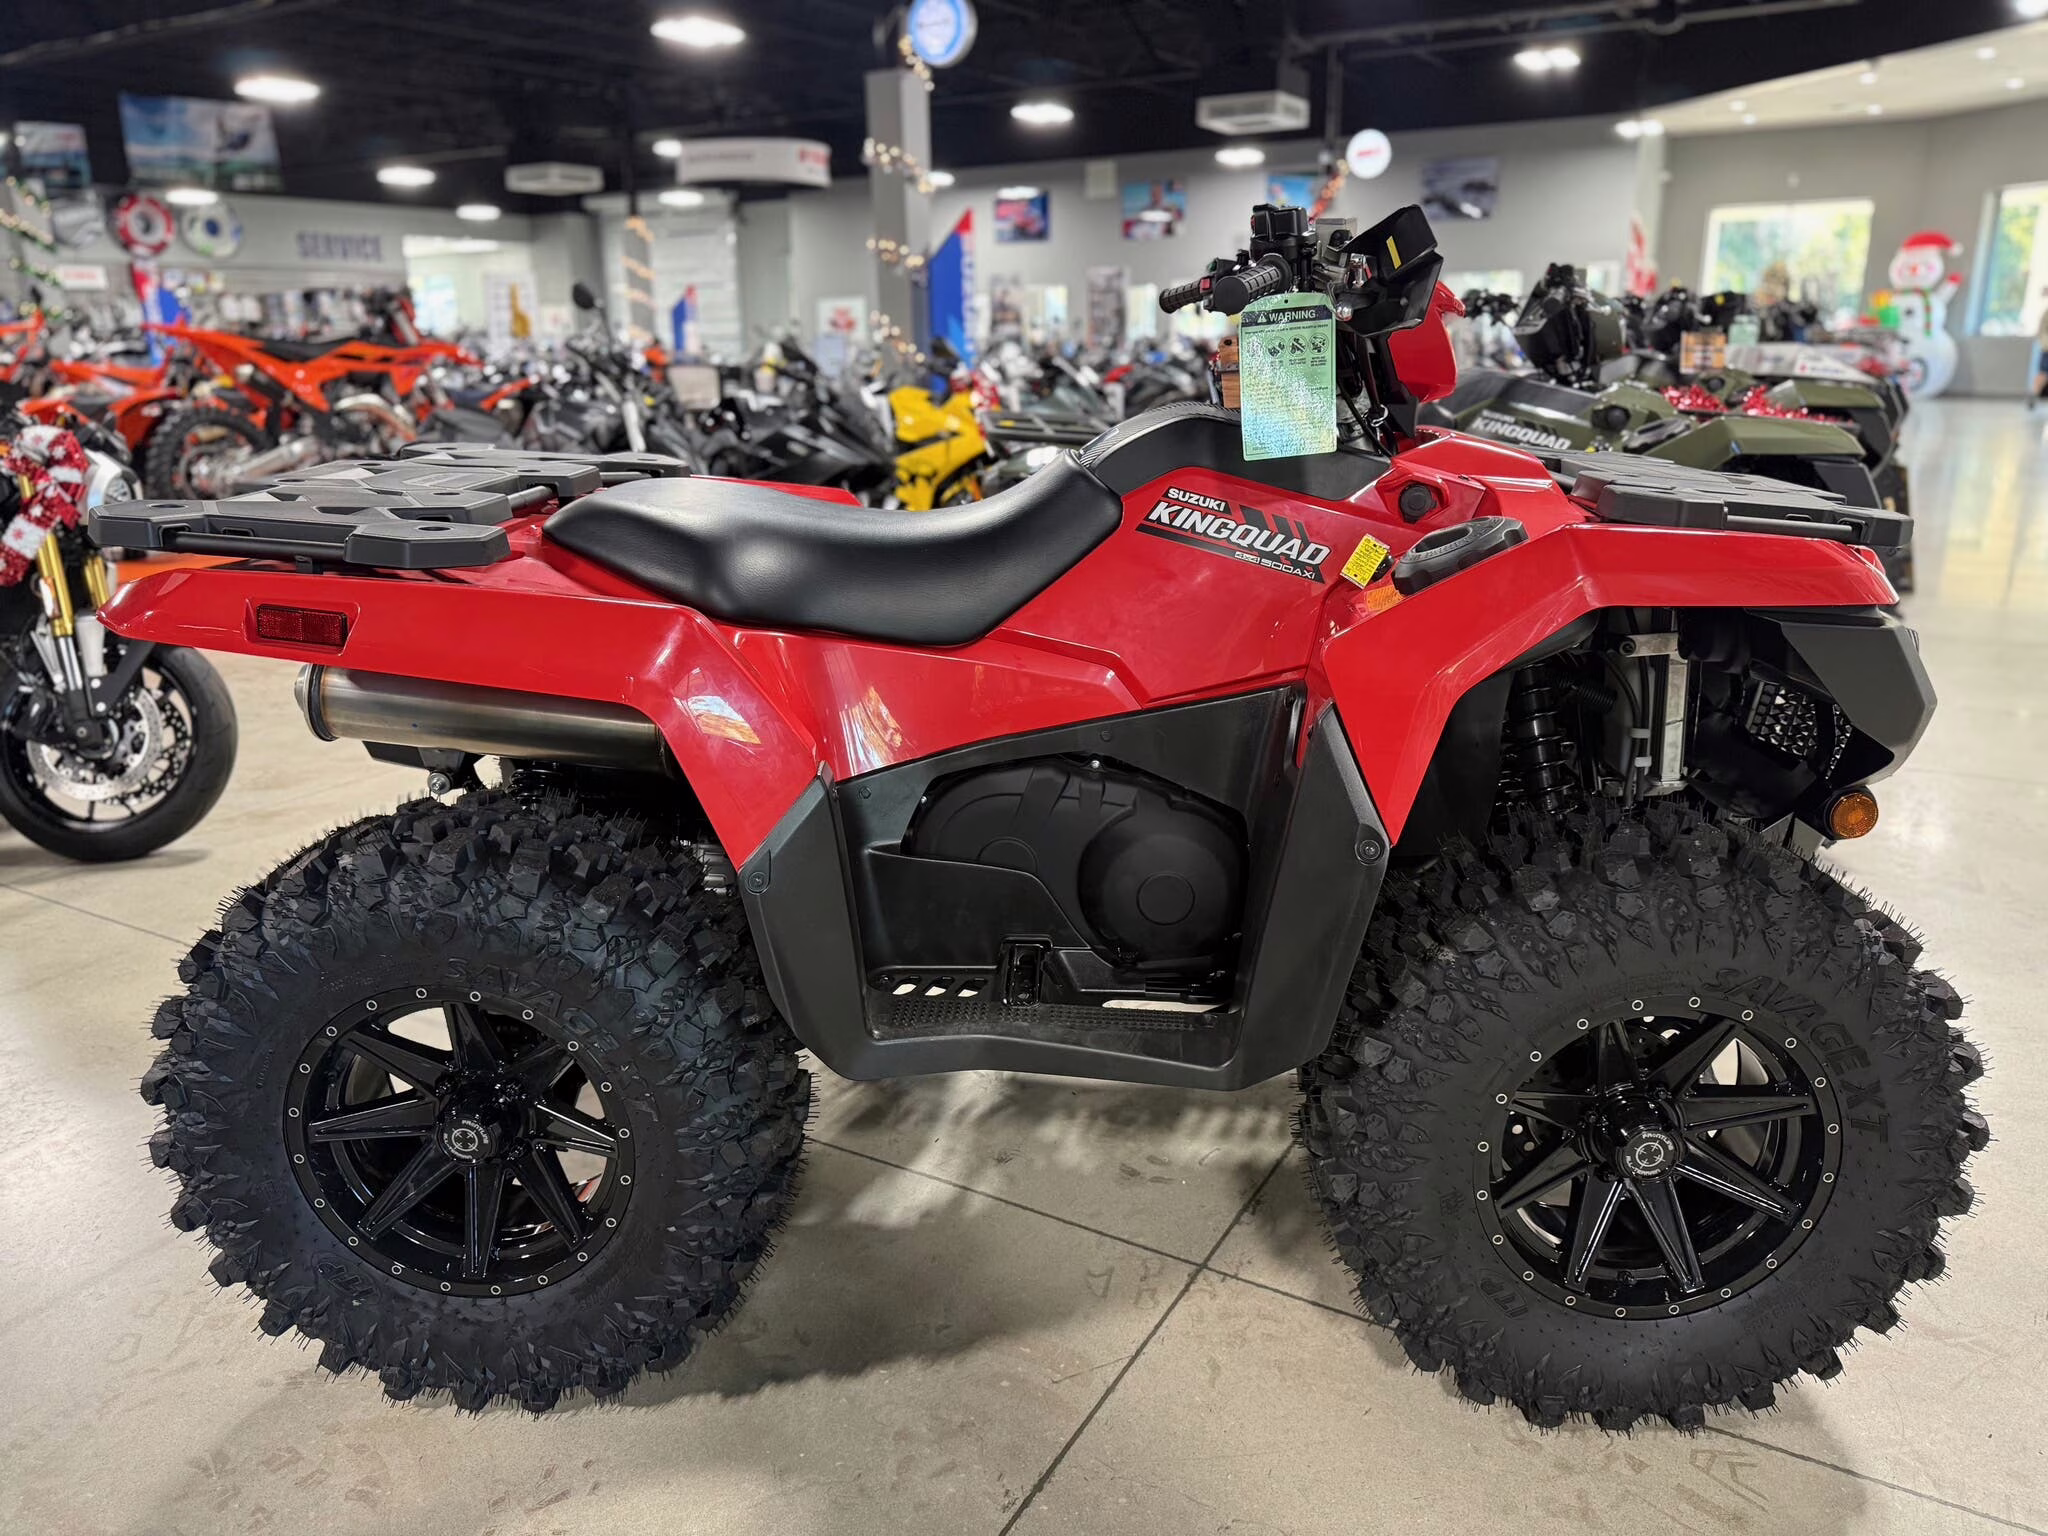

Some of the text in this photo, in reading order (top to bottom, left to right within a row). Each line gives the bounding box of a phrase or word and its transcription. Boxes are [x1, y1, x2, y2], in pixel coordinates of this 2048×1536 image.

[295, 231, 382, 260] SERVICE
[1269, 310, 1316, 322] WARNING
[1471, 417, 1572, 450] KINGQUAD
[1167, 488, 1226, 511] SUZUKI
[1148, 501, 1331, 565] KINGQUAD
[445, 957, 622, 1056] SAVAGE
[1702, 967, 1891, 1144] SAVAGE XT
[1479, 1271, 1530, 1319] ITP
